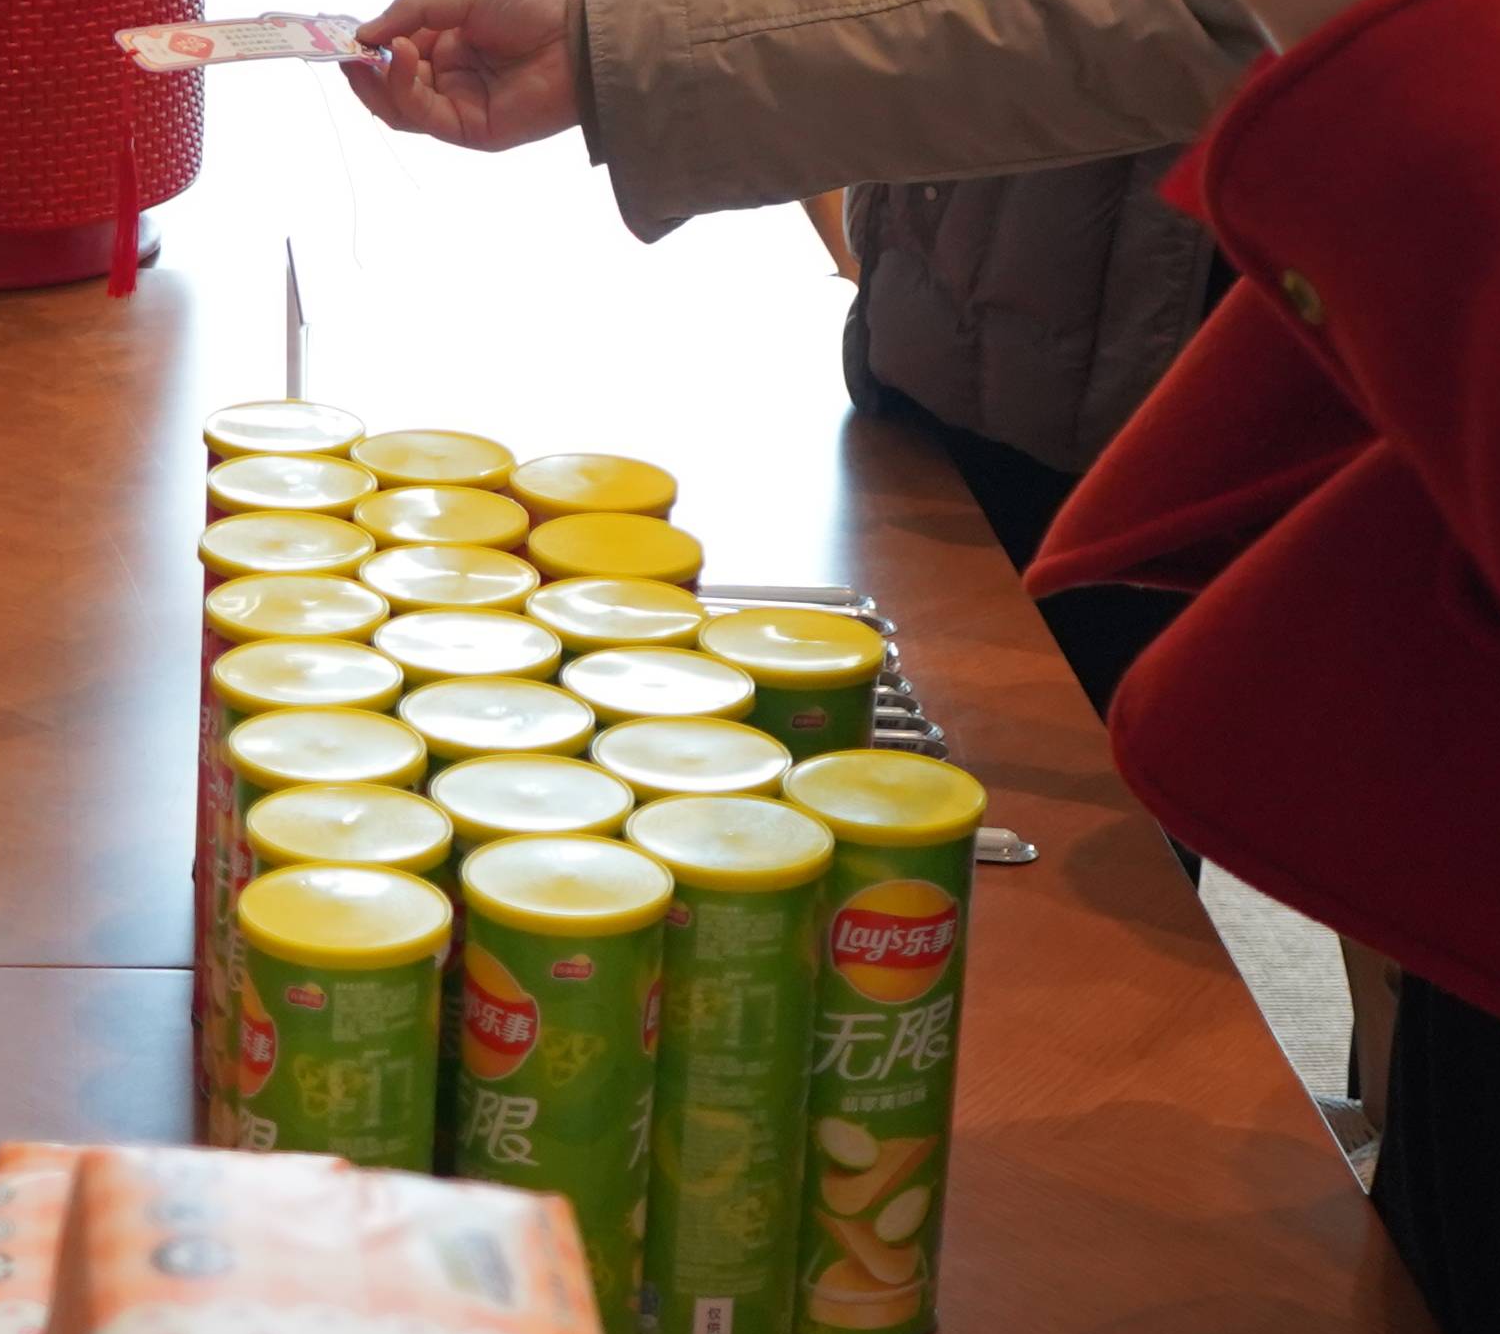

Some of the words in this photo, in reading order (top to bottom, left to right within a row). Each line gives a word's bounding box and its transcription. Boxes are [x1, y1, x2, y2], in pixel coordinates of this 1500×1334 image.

[902, 919, 957, 957] 乐事
[478, 1001, 535, 1044] 乐事
[813, 993, 954, 1081] 无限
